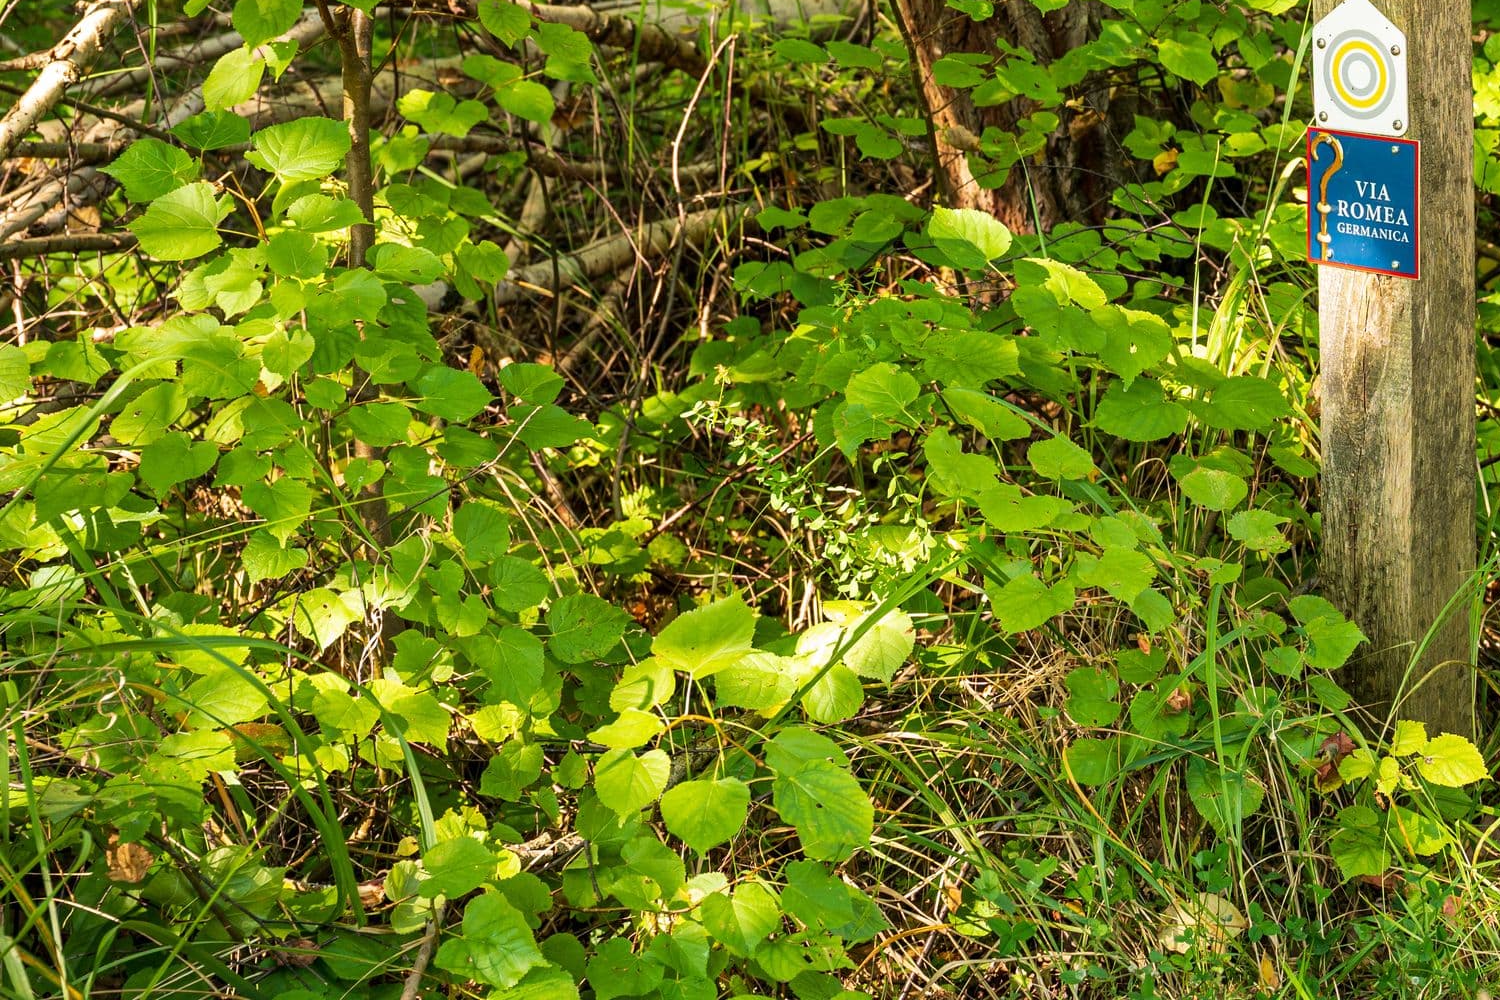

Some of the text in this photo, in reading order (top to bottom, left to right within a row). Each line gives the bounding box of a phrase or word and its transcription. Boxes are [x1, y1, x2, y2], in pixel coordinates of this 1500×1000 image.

[1355, 180, 1391, 202] VIA
[1337, 199, 1409, 226] ROMEA
[1336, 222, 1410, 243] GERMANICA
